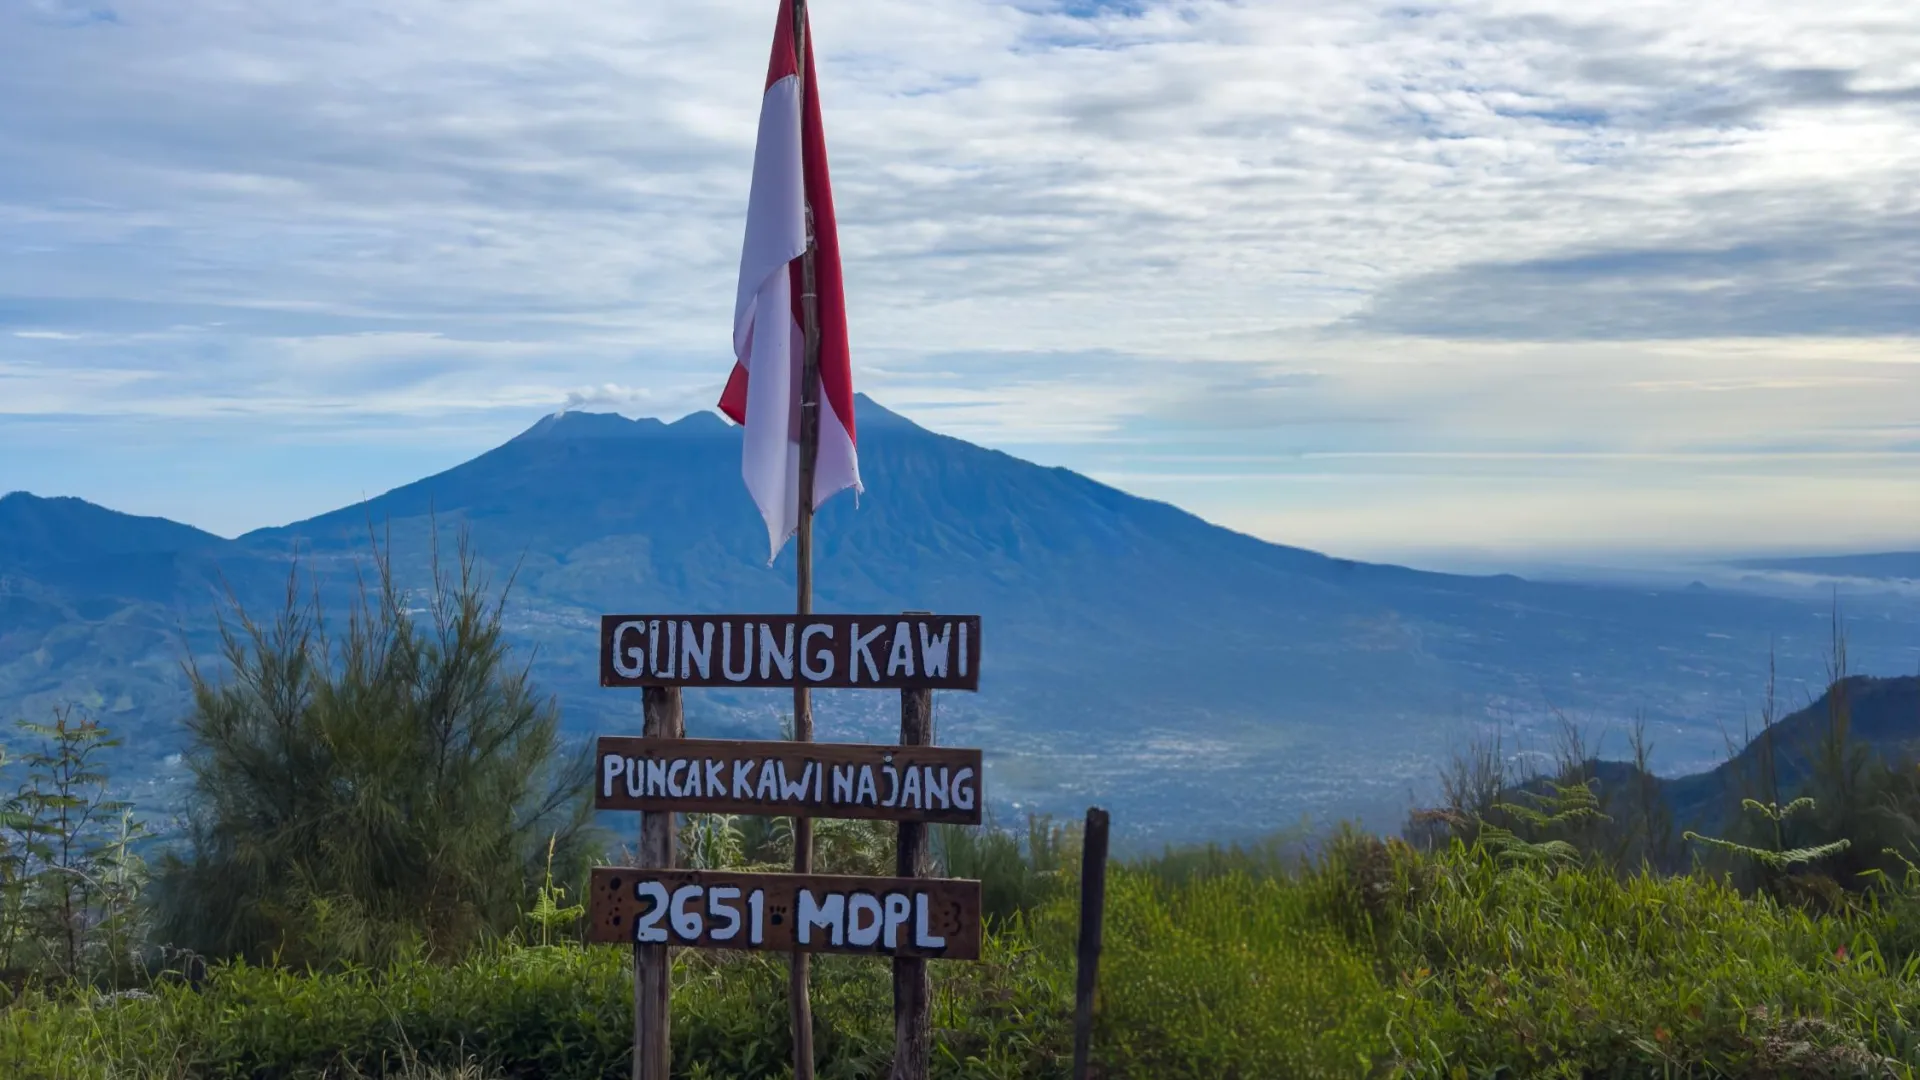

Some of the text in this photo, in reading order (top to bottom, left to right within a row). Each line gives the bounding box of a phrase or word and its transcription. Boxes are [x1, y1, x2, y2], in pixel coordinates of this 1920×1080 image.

[613, 620, 968, 682] GUNUNG KAWI
[603, 754, 726, 798] PUNCAK
[733, 759, 823, 802] KAWI
[637, 881, 945, 948] 2651 MDPL
